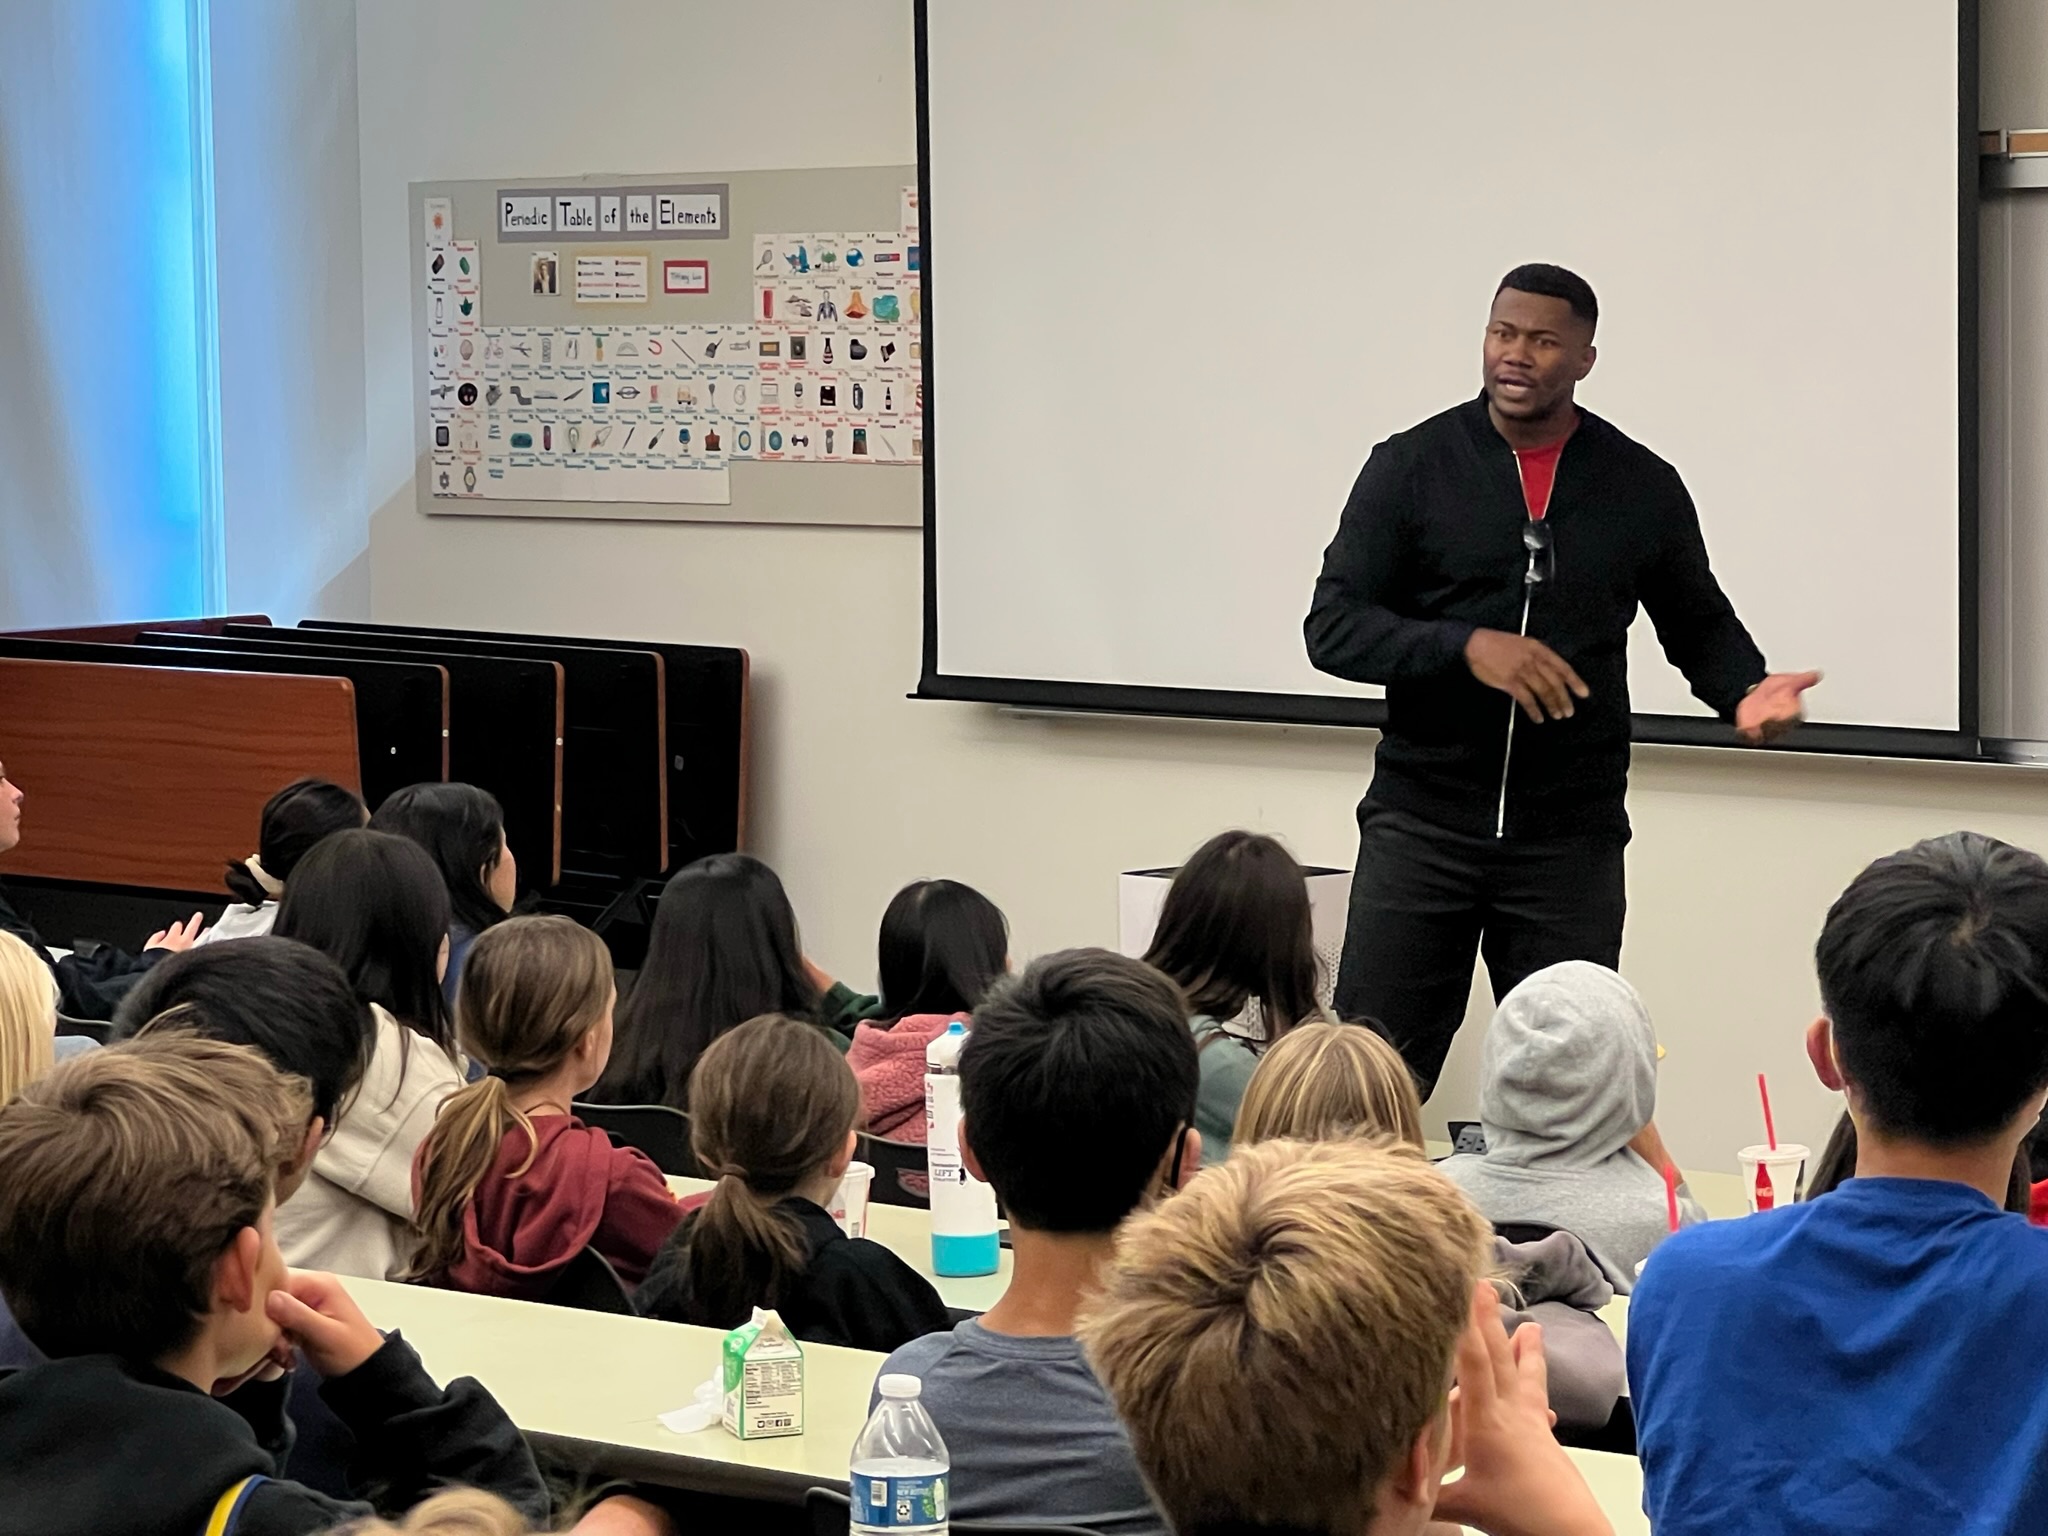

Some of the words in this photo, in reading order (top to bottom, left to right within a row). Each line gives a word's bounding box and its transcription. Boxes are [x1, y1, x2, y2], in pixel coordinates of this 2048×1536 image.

[505, 202, 547, 227] Periodic
[559, 202, 593, 226] Table
[604, 208, 617, 224] of
[630, 207, 649, 224] the
[660, 199, 717, 224] Elements
